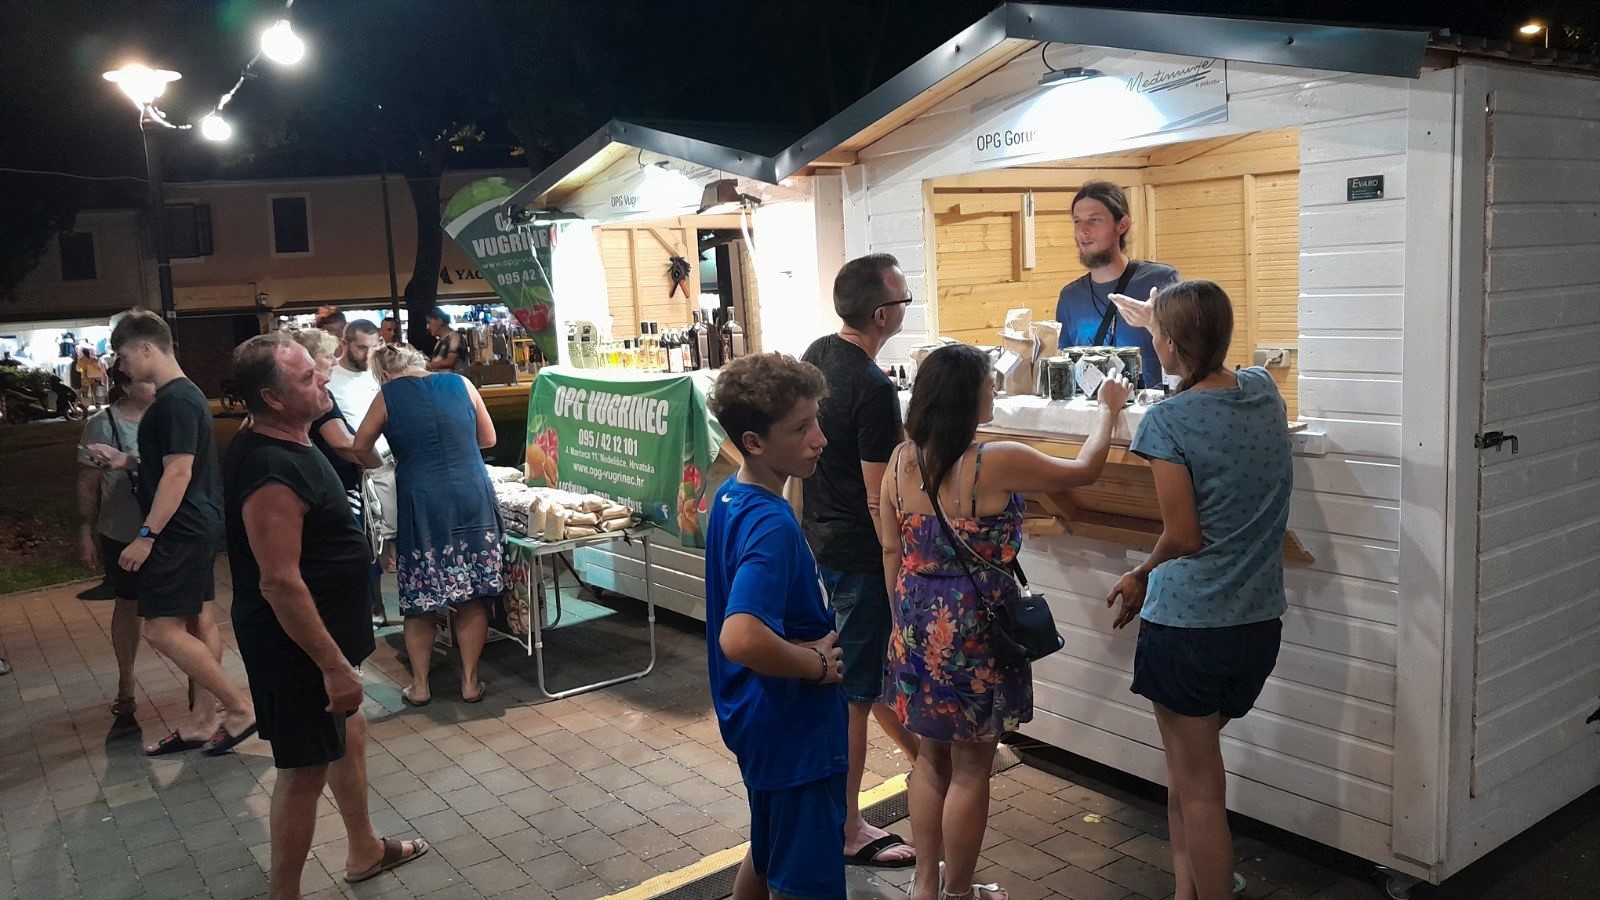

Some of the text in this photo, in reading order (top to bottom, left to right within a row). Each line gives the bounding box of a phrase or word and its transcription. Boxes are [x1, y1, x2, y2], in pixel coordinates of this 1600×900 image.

[977, 132, 1001, 151] OPG
[610, 195, 624, 208] OPG
[497, 271, 521, 286] 095
[522, 269, 536, 282] 42
[554, 385, 669, 436] OPG VUGRINEC
[578, 428, 638, 457] 095 / 42 12 101
[573, 462, 645, 487] www.opg-vugrinec.hr
[629, 459, 655, 474] Hrvatska
